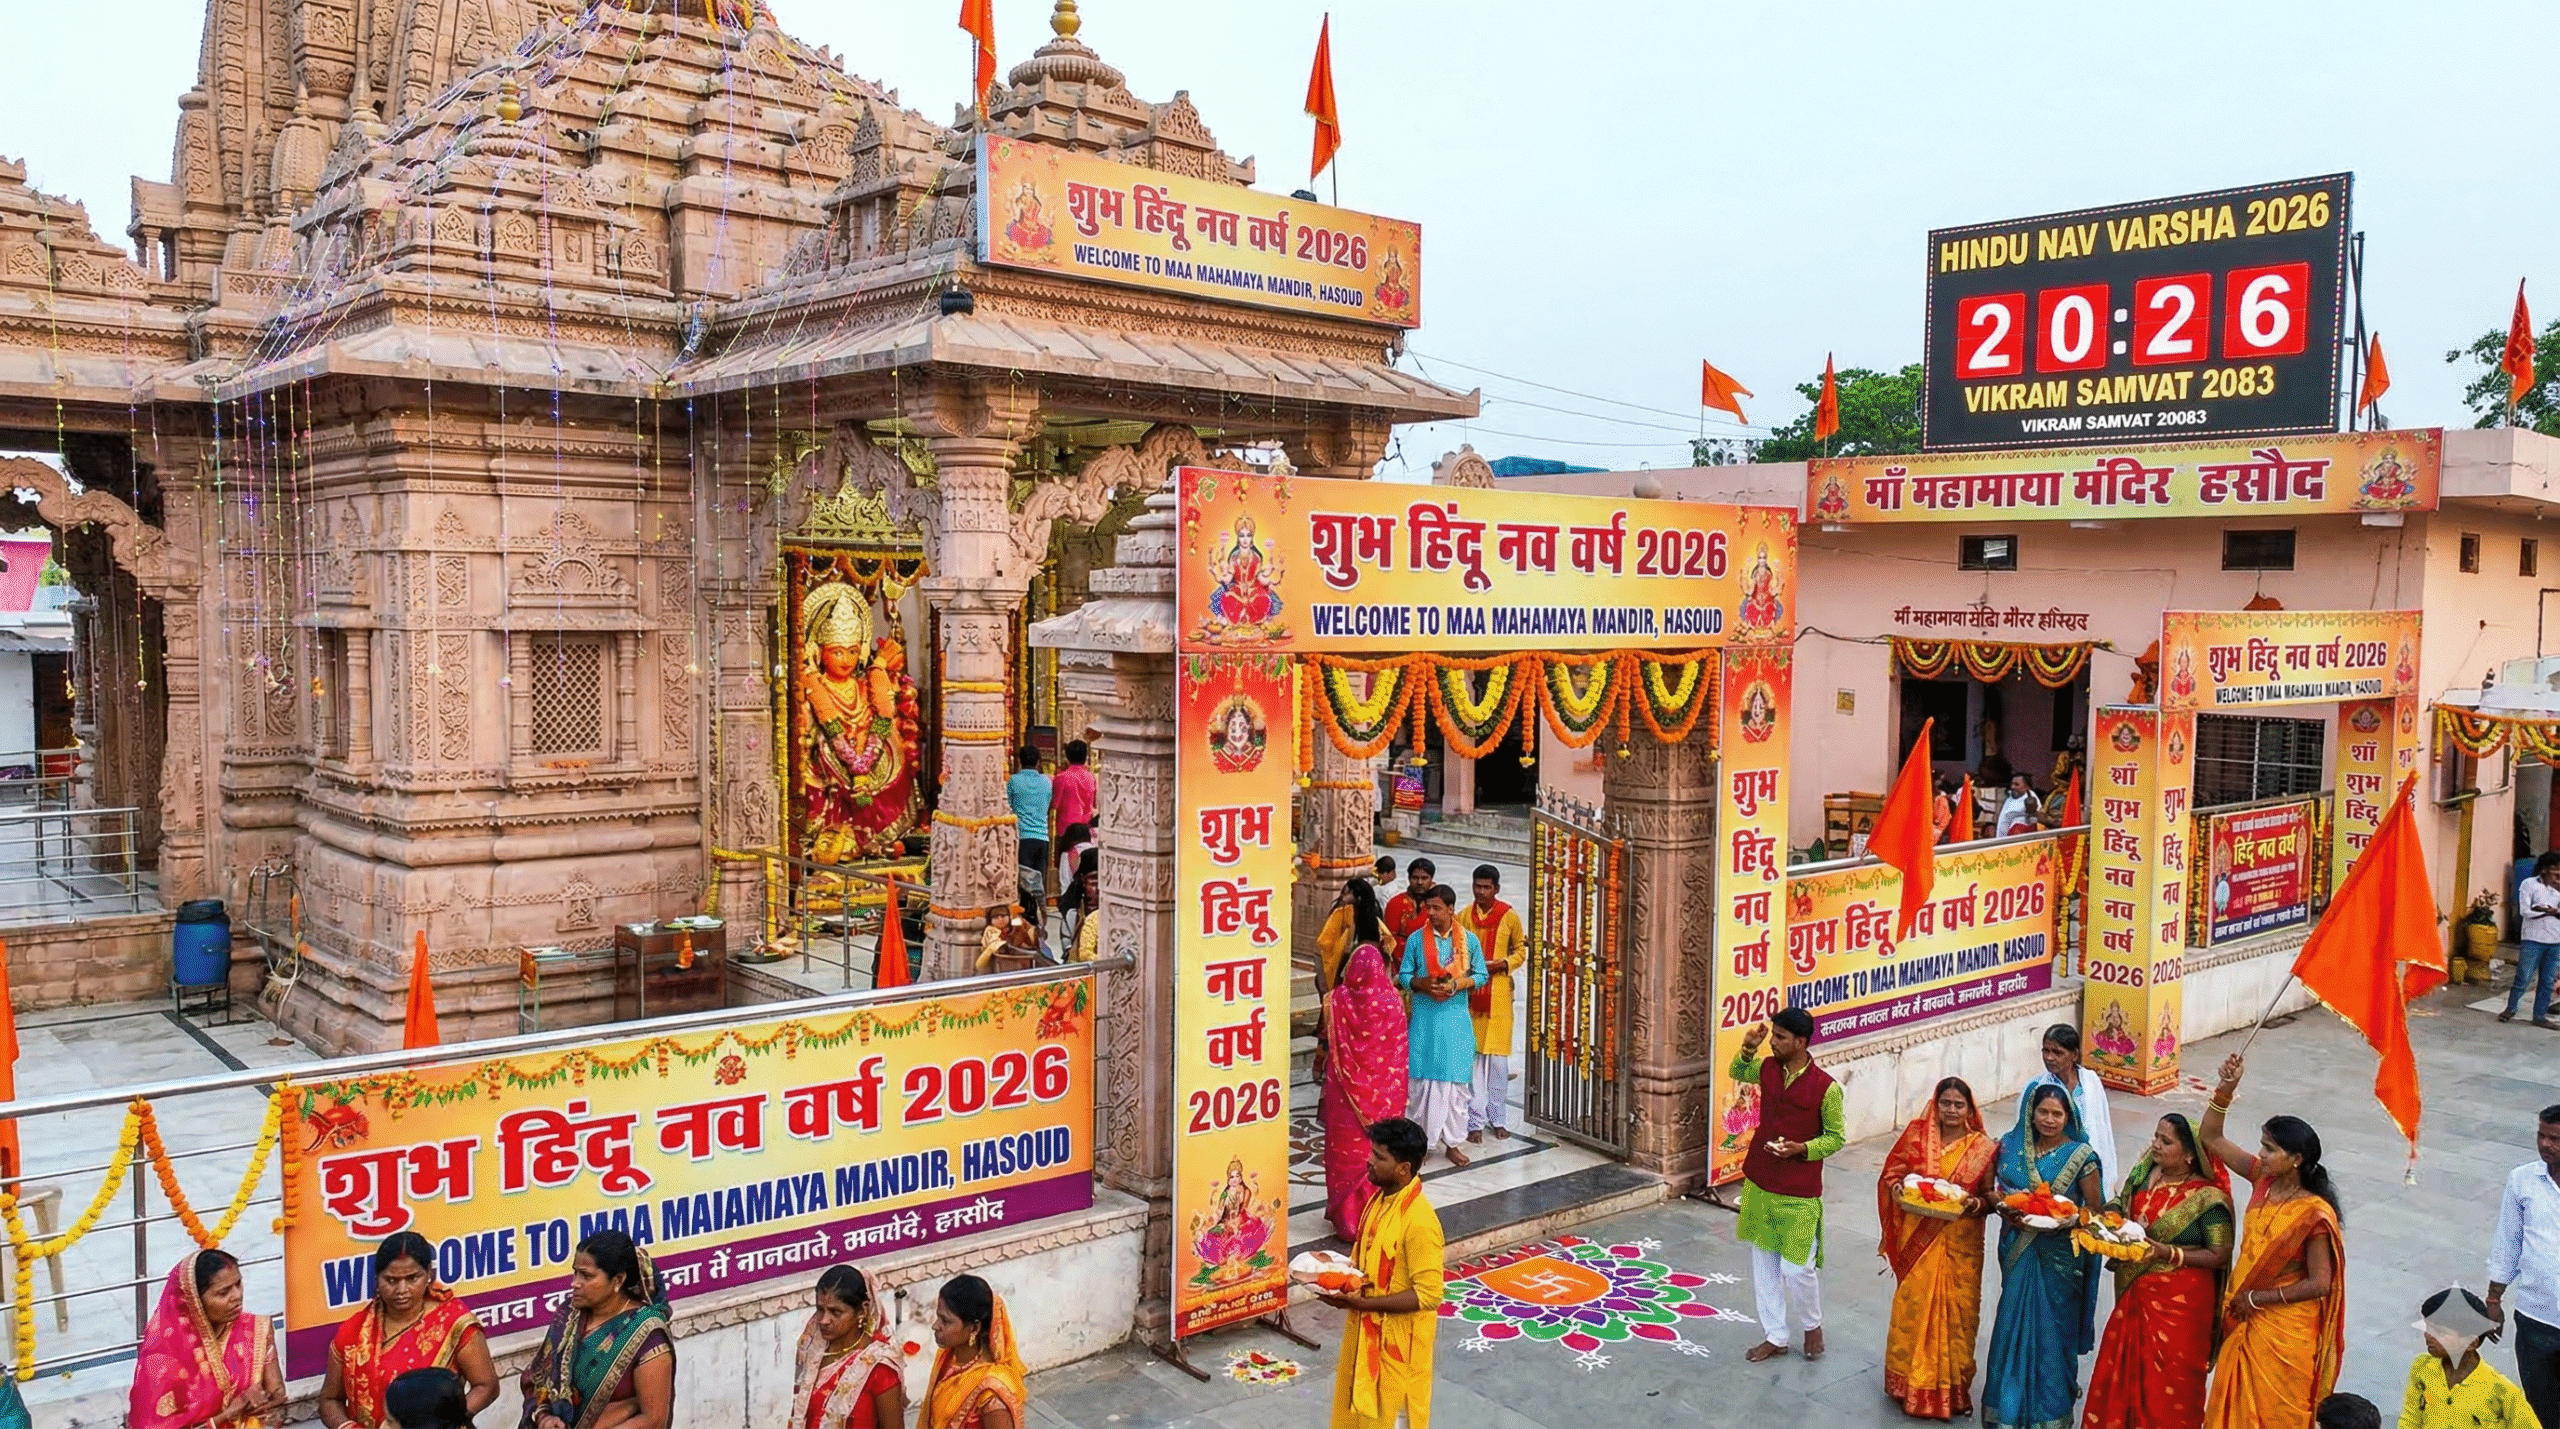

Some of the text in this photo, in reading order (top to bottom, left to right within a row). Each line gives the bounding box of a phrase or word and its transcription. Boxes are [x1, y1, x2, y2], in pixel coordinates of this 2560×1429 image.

[1067, 181, 1367, 270] शुभ हिंदू नव वर्ष 2026
[1941, 192, 2329, 272] HINDU NAV VARSHA 2026
[1074, 244, 1362, 307] WELCOME TO MAA MAHAMAYA MANDIR, HASOUD
[1965, 365, 2274, 412] VIKRAM SAMVAT 2083
[2021, 410, 2207, 432] VIKRAM SAMVAT 20083
[1912, 471, 2060, 509] महामाया
[2073, 457, 2175, 506] मंदिर
[2199, 448, 2331, 504] हसौद
[1310, 503, 1727, 592] शुभ हिंदू नव वर्ष 2026
[1313, 605, 1722, 638] WELCOME TO MAA MAHAMAYA MANDIR, HASOUD
[2210, 636, 2387, 682] शुभ हिंदू नव वर्ष 2026
[1733, 768, 1778, 819] शुभ
[2165, 788, 2186, 823] शुभ
[2346, 774, 2381, 794] शुभ
[1200, 805, 1273, 863] शुभ
[2104, 799, 2141, 823] शुभ
[2345, 800, 2380, 826] हिंदू
[1732, 827, 1779, 883] हिंदू
[2104, 828, 2141, 861] हिंदू
[2105, 867, 2135, 887] नव
[2163, 882, 2180, 905] नव
[1201, 877, 1277, 942] हिंदू
[1733, 891, 1771, 928] नव
[1789, 918, 1838, 974] शुभ
[1846, 900, 1895, 956] हिंदू
[1943, 884, 1978, 931] वर्ष
[1984, 882, 2045, 925] 2026
[2104, 899, 2135, 920] नव
[2162, 912, 2179, 943] वर्ष
[1733, 934, 1770, 980] वर्ष
[2103, 929, 2134, 953] वर्ष
[1206, 958, 1266, 1001] नव
[1787, 975, 1849, 1009] WELCOME
[1853, 971, 1867, 998] TO
[1871, 964, 1895, 993] MAA
[1900, 953, 1953, 986] MAHMAYA
[2004, 933, 2045, 963] HASOUD
[2090, 961, 2143, 987] 2026
[2153, 957, 2182, 984] 2026
[1721, 987, 1779, 1031] 2026
[1207, 1007, 1266, 1068] वर्ष
[1188, 1078, 1281, 1134] 2026
[322, 1044, 1070, 1236] शुभ हिंदू नव वर्ष 2026
[325, 1228, 515, 1307] WOME
[525, 1219, 570, 1267] TO
[662, 1168, 828, 1242] MAIAMAYA
[836, 1147, 956, 1207] MANDIR,
[963, 1125, 1070, 1183] HASOUD
